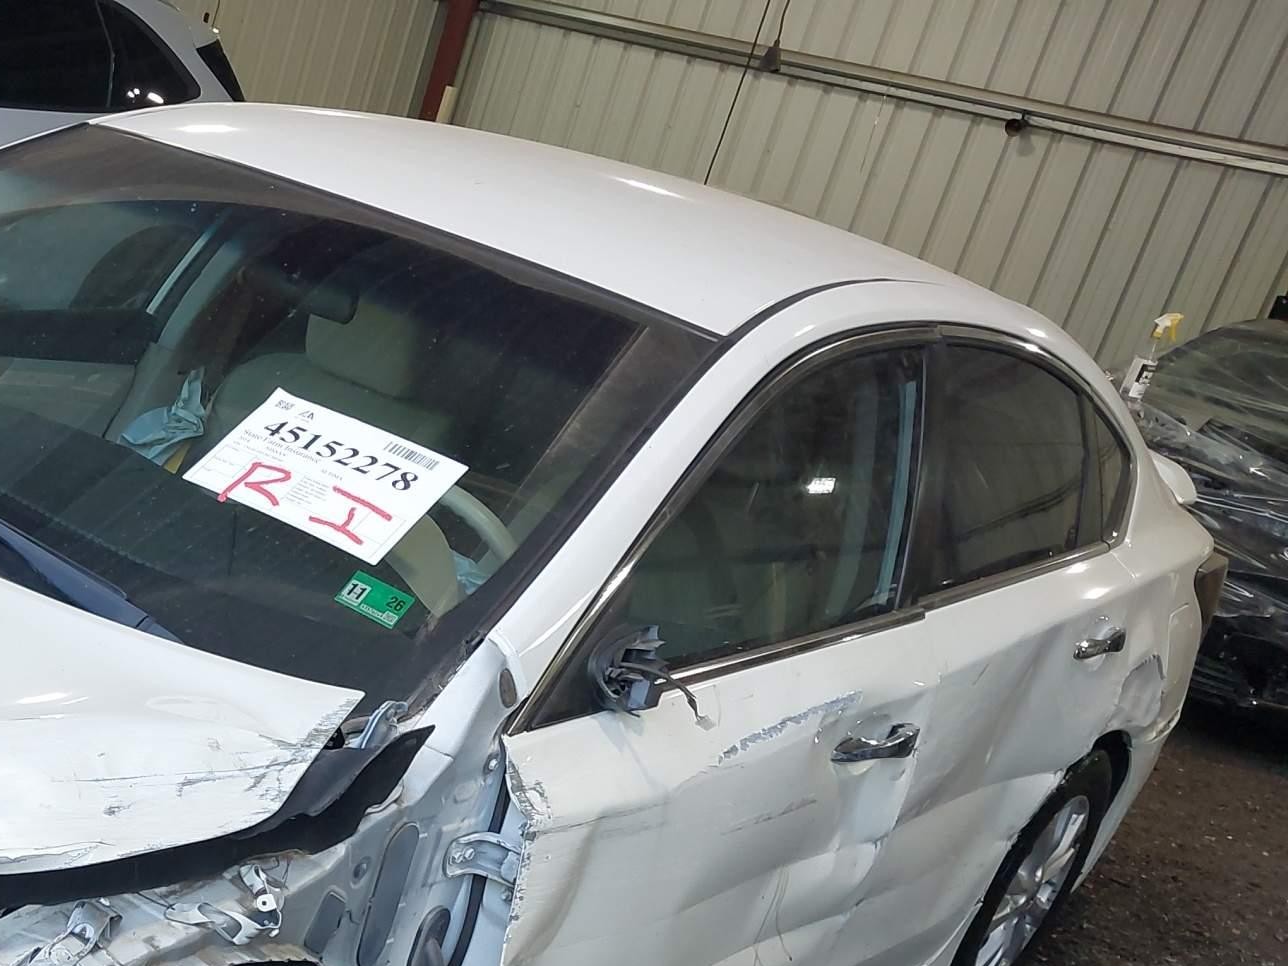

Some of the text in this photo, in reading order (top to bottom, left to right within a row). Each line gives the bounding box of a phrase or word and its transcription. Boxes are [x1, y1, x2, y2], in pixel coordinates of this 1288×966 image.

[263, 420, 419, 491] 45152278
[217, 461, 292, 506] R
[346, 582, 368, 601] 11
[385, 596, 406, 612] 26
